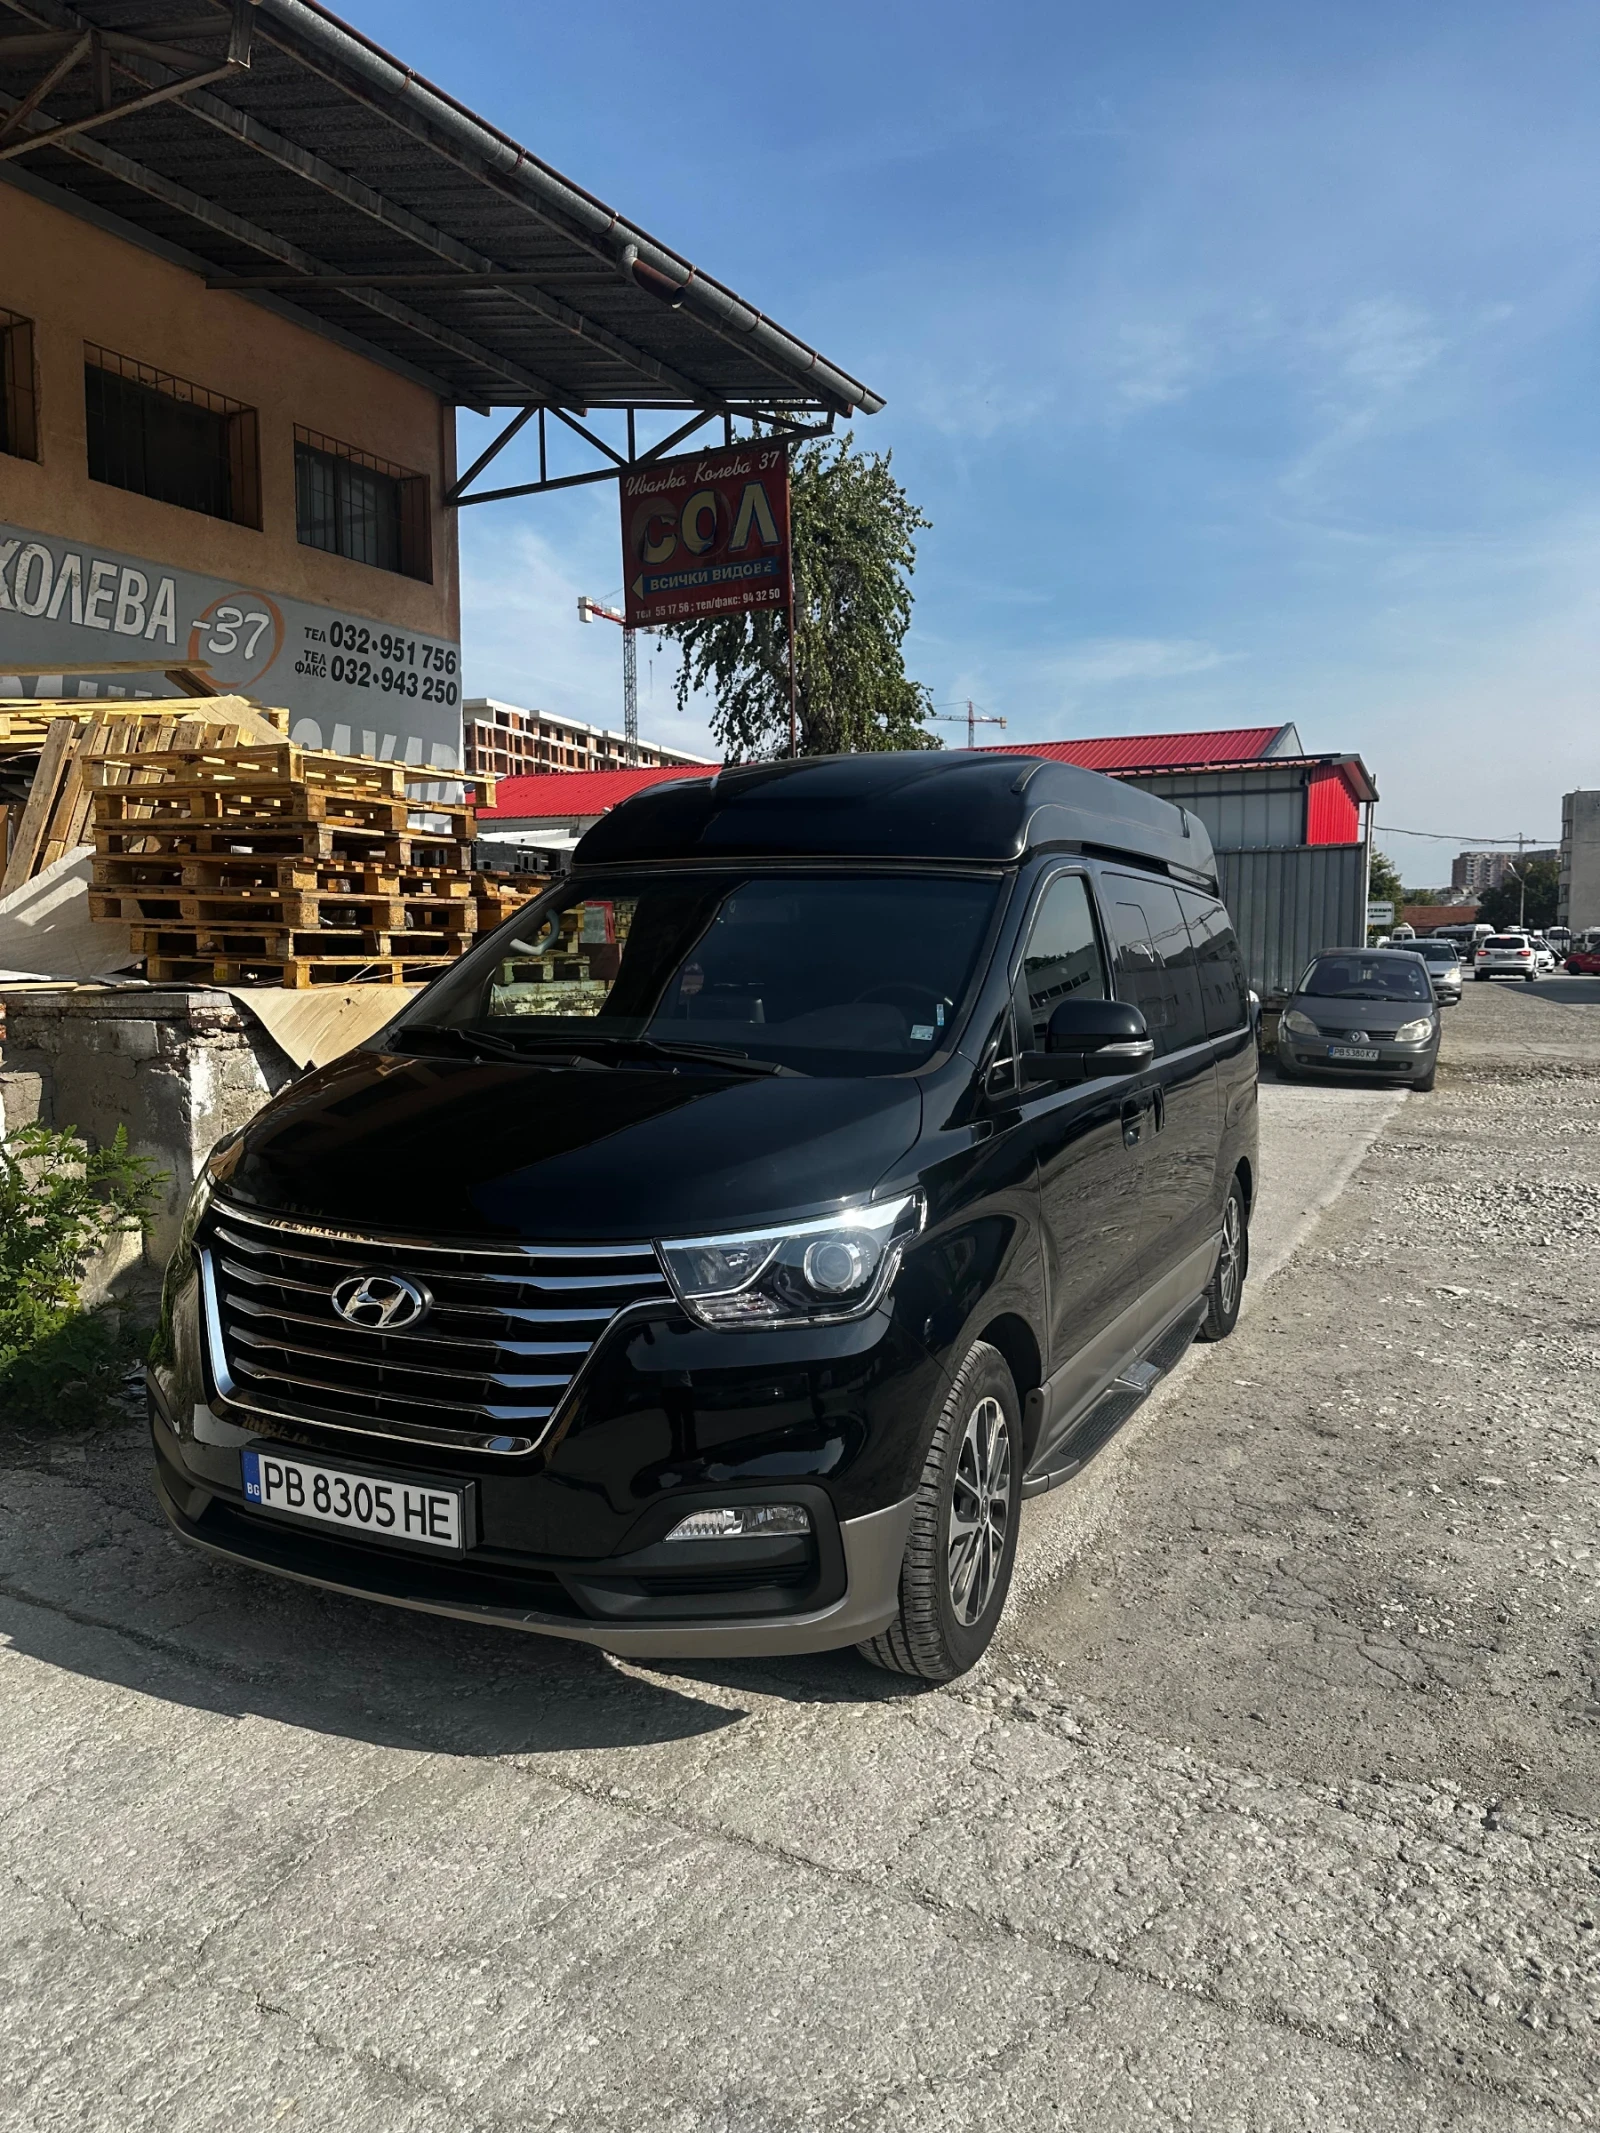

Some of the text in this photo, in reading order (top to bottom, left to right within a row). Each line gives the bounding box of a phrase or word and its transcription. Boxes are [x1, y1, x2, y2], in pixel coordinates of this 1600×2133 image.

[626, 450, 780, 497] Иванка Колева 37
[631, 479, 782, 565] СОЛ
[650, 572, 708, 591] ВСИЧКИ
[655, 606, 666, 617] 55
[667, 604, 677, 615] 17
[743, 592, 754, 604] 94
[755, 589, 767, 602] 32
[768, 588, 780, 600] 50
[303, 650, 327, 666] ТЕЛ
[304, 627, 326, 643] ТЕЛ
[422, 644, 457, 675] 756
[294, 660, 327, 678] ФАКС
[421, 676, 458, 706] 250
[247, 1482, 260, 1497] BG
[264, 1461, 453, 1541] PB 8305 HE
